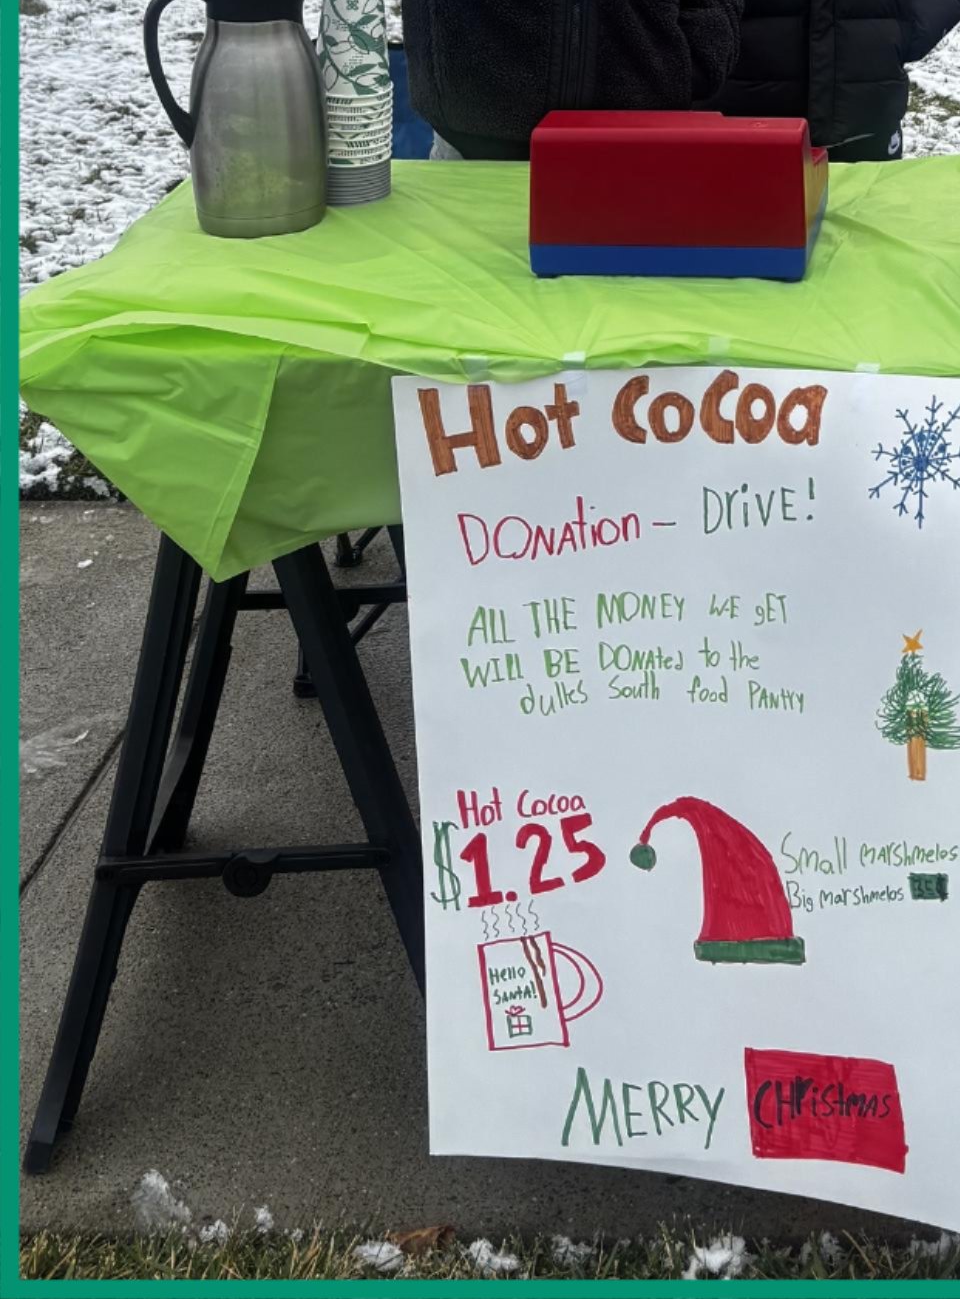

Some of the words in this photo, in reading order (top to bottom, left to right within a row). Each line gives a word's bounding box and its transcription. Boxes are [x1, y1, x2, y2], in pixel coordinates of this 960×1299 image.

[417, 383, 580, 477] Hot
[467, 605, 517, 647] ALL
[522, 596, 578, 638] THE
[597, 591, 685, 630] MONEY
[709, 593, 741, 620] WE
[543, 648, 581, 678] BE
[698, 636, 721, 669] to
[728, 640, 761, 672] the
[607, 670, 660, 701] South
[686, 675, 729, 704] food
[456, 786, 503, 829] Hot
[430, 812, 607, 912] $1.25
[780, 831, 848, 875] Small
[786, 880, 814, 913] Big
[489, 966, 526, 986] Hello
[561, 1066, 726, 1150] MERRY
